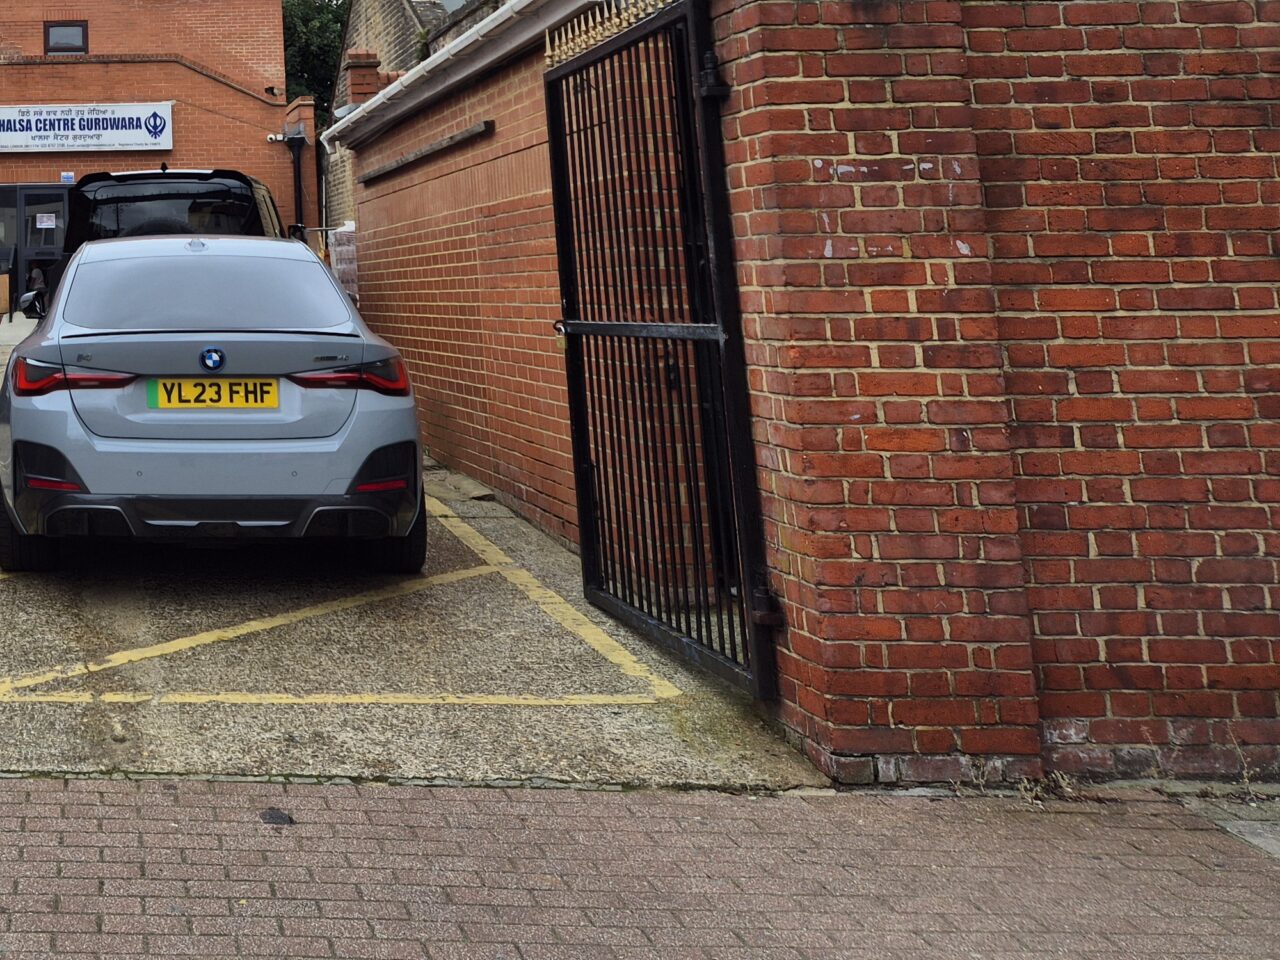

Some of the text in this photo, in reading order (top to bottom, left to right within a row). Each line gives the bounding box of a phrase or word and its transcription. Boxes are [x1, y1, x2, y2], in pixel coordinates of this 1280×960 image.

[35, 117, 76, 132] CENTRE
[78, 116, 143, 132] GURDWARA
[161, 380, 273, 404] YL23 FHF
